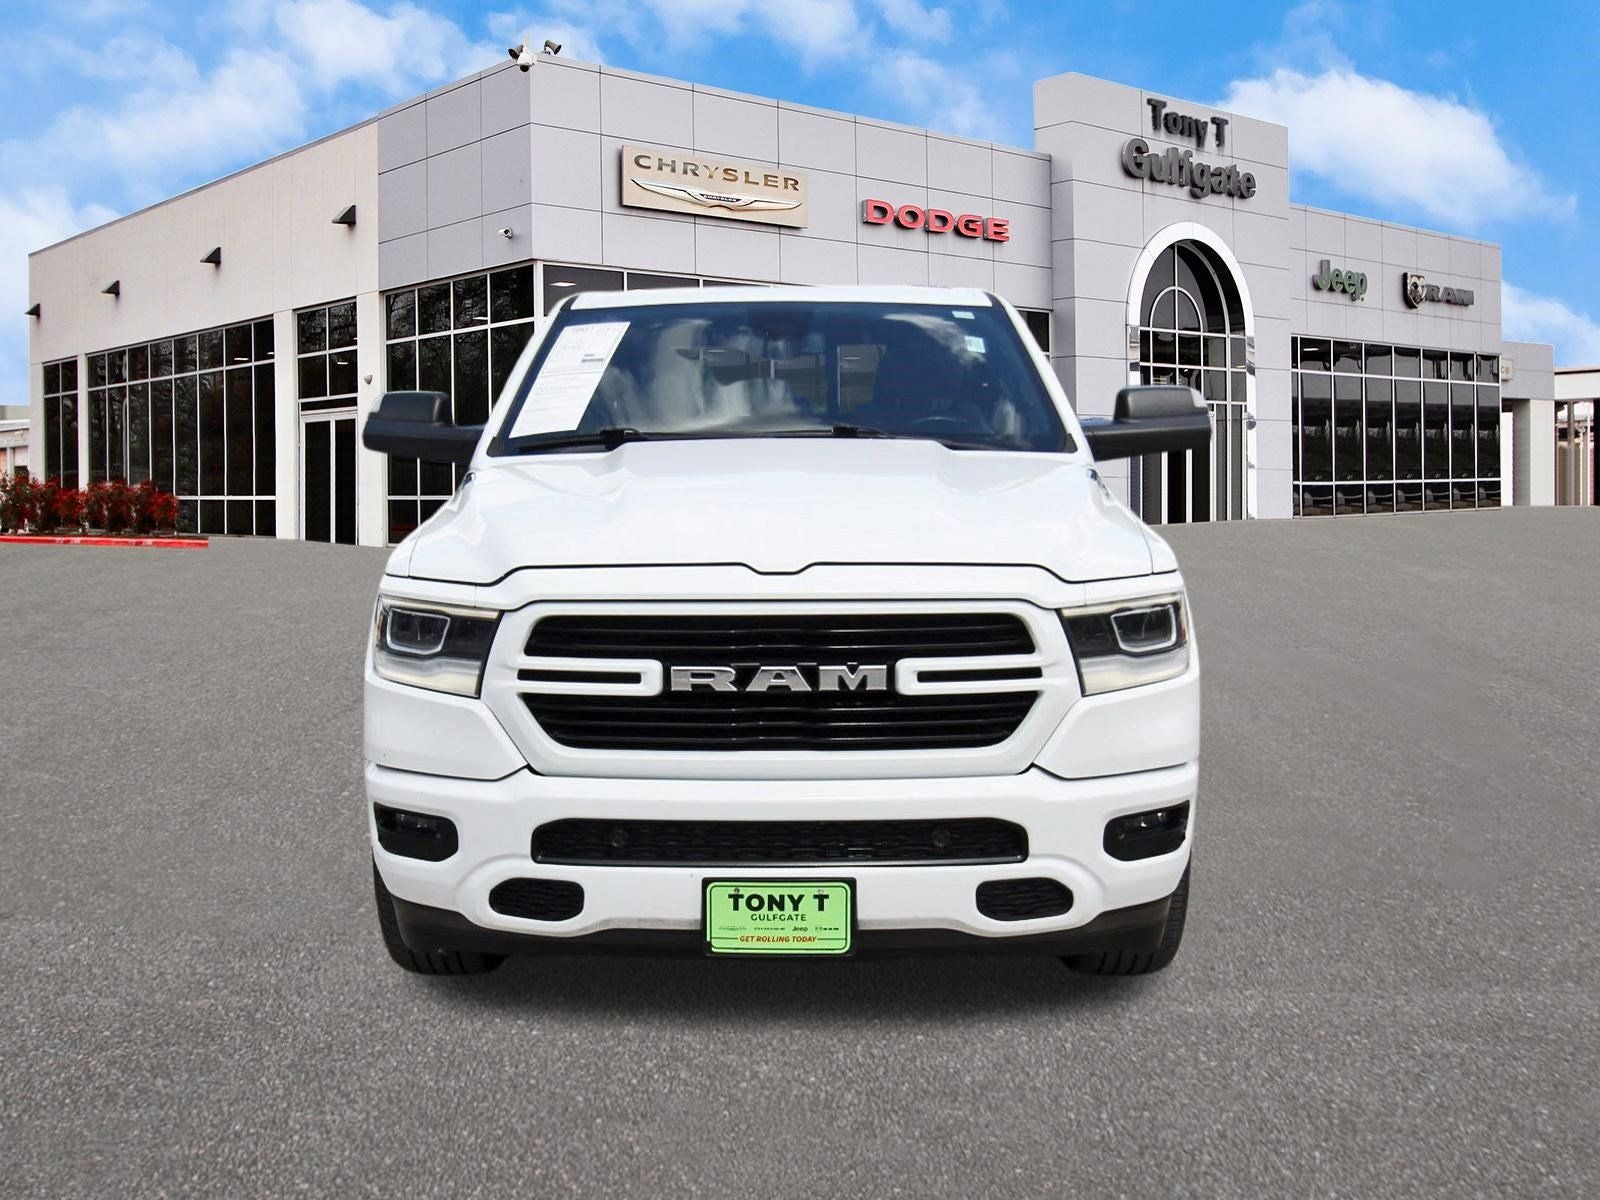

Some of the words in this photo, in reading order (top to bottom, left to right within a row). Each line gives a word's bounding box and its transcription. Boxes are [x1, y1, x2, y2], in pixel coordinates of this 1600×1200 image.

[1146, 98, 1208, 147] Tony
[1211, 116, 1229, 147] T
[633, 154, 800, 192] CHRYSLER
[1121, 137, 1257, 199] Gulfgate
[862, 198, 1011, 242] DODGE
[1312, 259, 1368, 302] Jeep
[1425, 283, 1475, 306] RAM
[670, 665, 888, 692] RAM
[728, 893, 805, 912] TONY
[813, 893, 830, 912] T
[750, 913, 807, 922] GULFGATE
[739, 935, 755, 943] GET
[756, 935, 790, 943] ROLLING
[791, 935, 817, 943] TODAY
